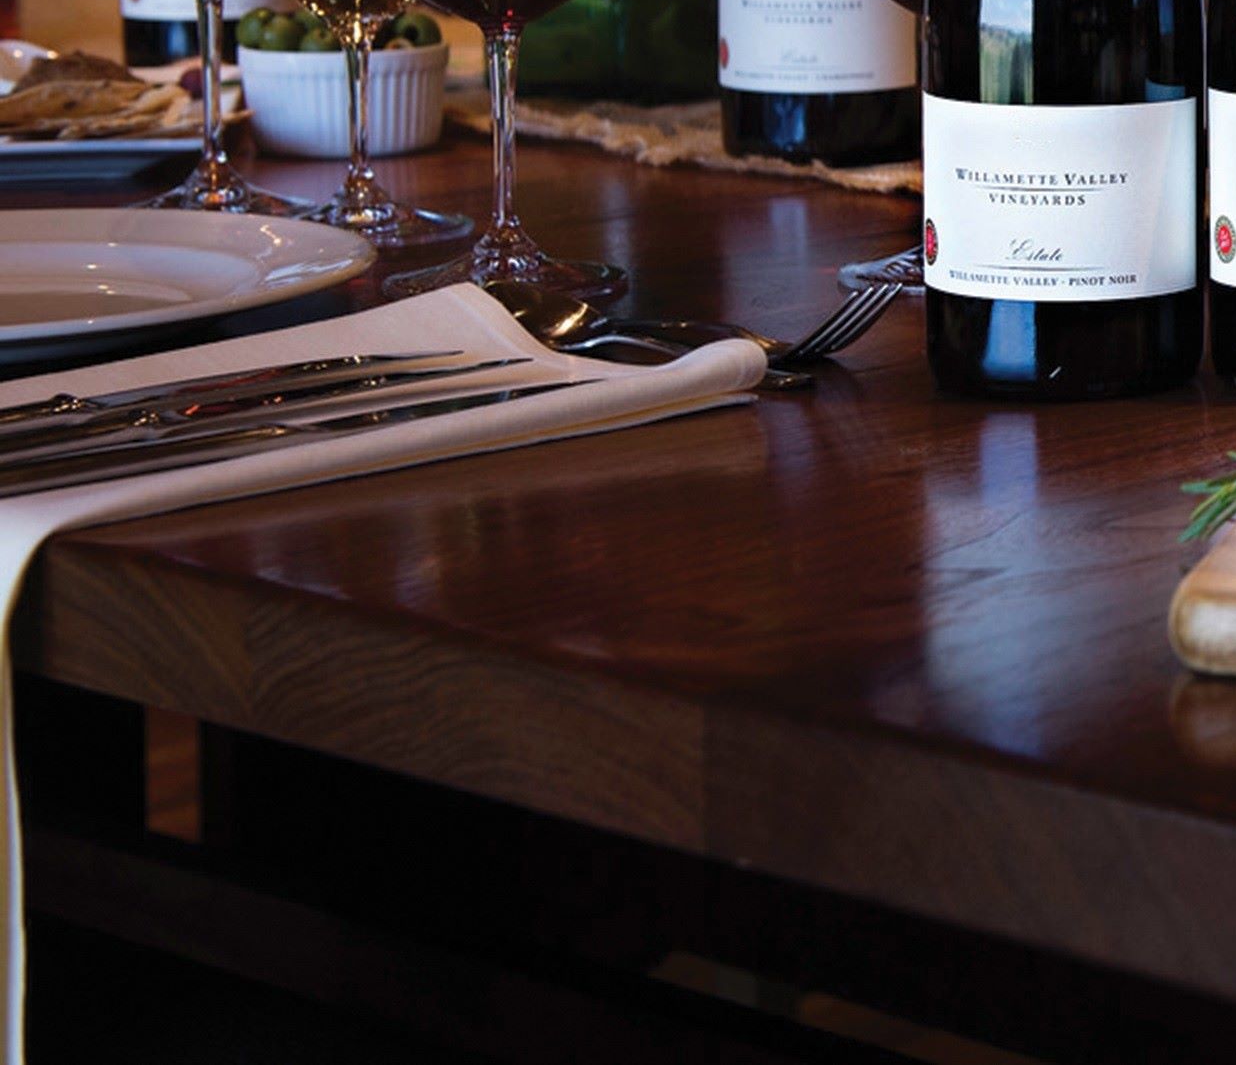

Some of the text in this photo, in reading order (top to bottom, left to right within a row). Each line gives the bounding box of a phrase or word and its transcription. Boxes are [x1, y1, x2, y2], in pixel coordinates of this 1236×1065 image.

[955, 168, 1128, 186] WILLAMETTE VALLEY
[989, 193, 1086, 206] VINEYARDS
[1005, 238, 1064, 262] Estate
[949, 270, 1137, 286] WILLAMETTE VALLEY PINOT NOIR
